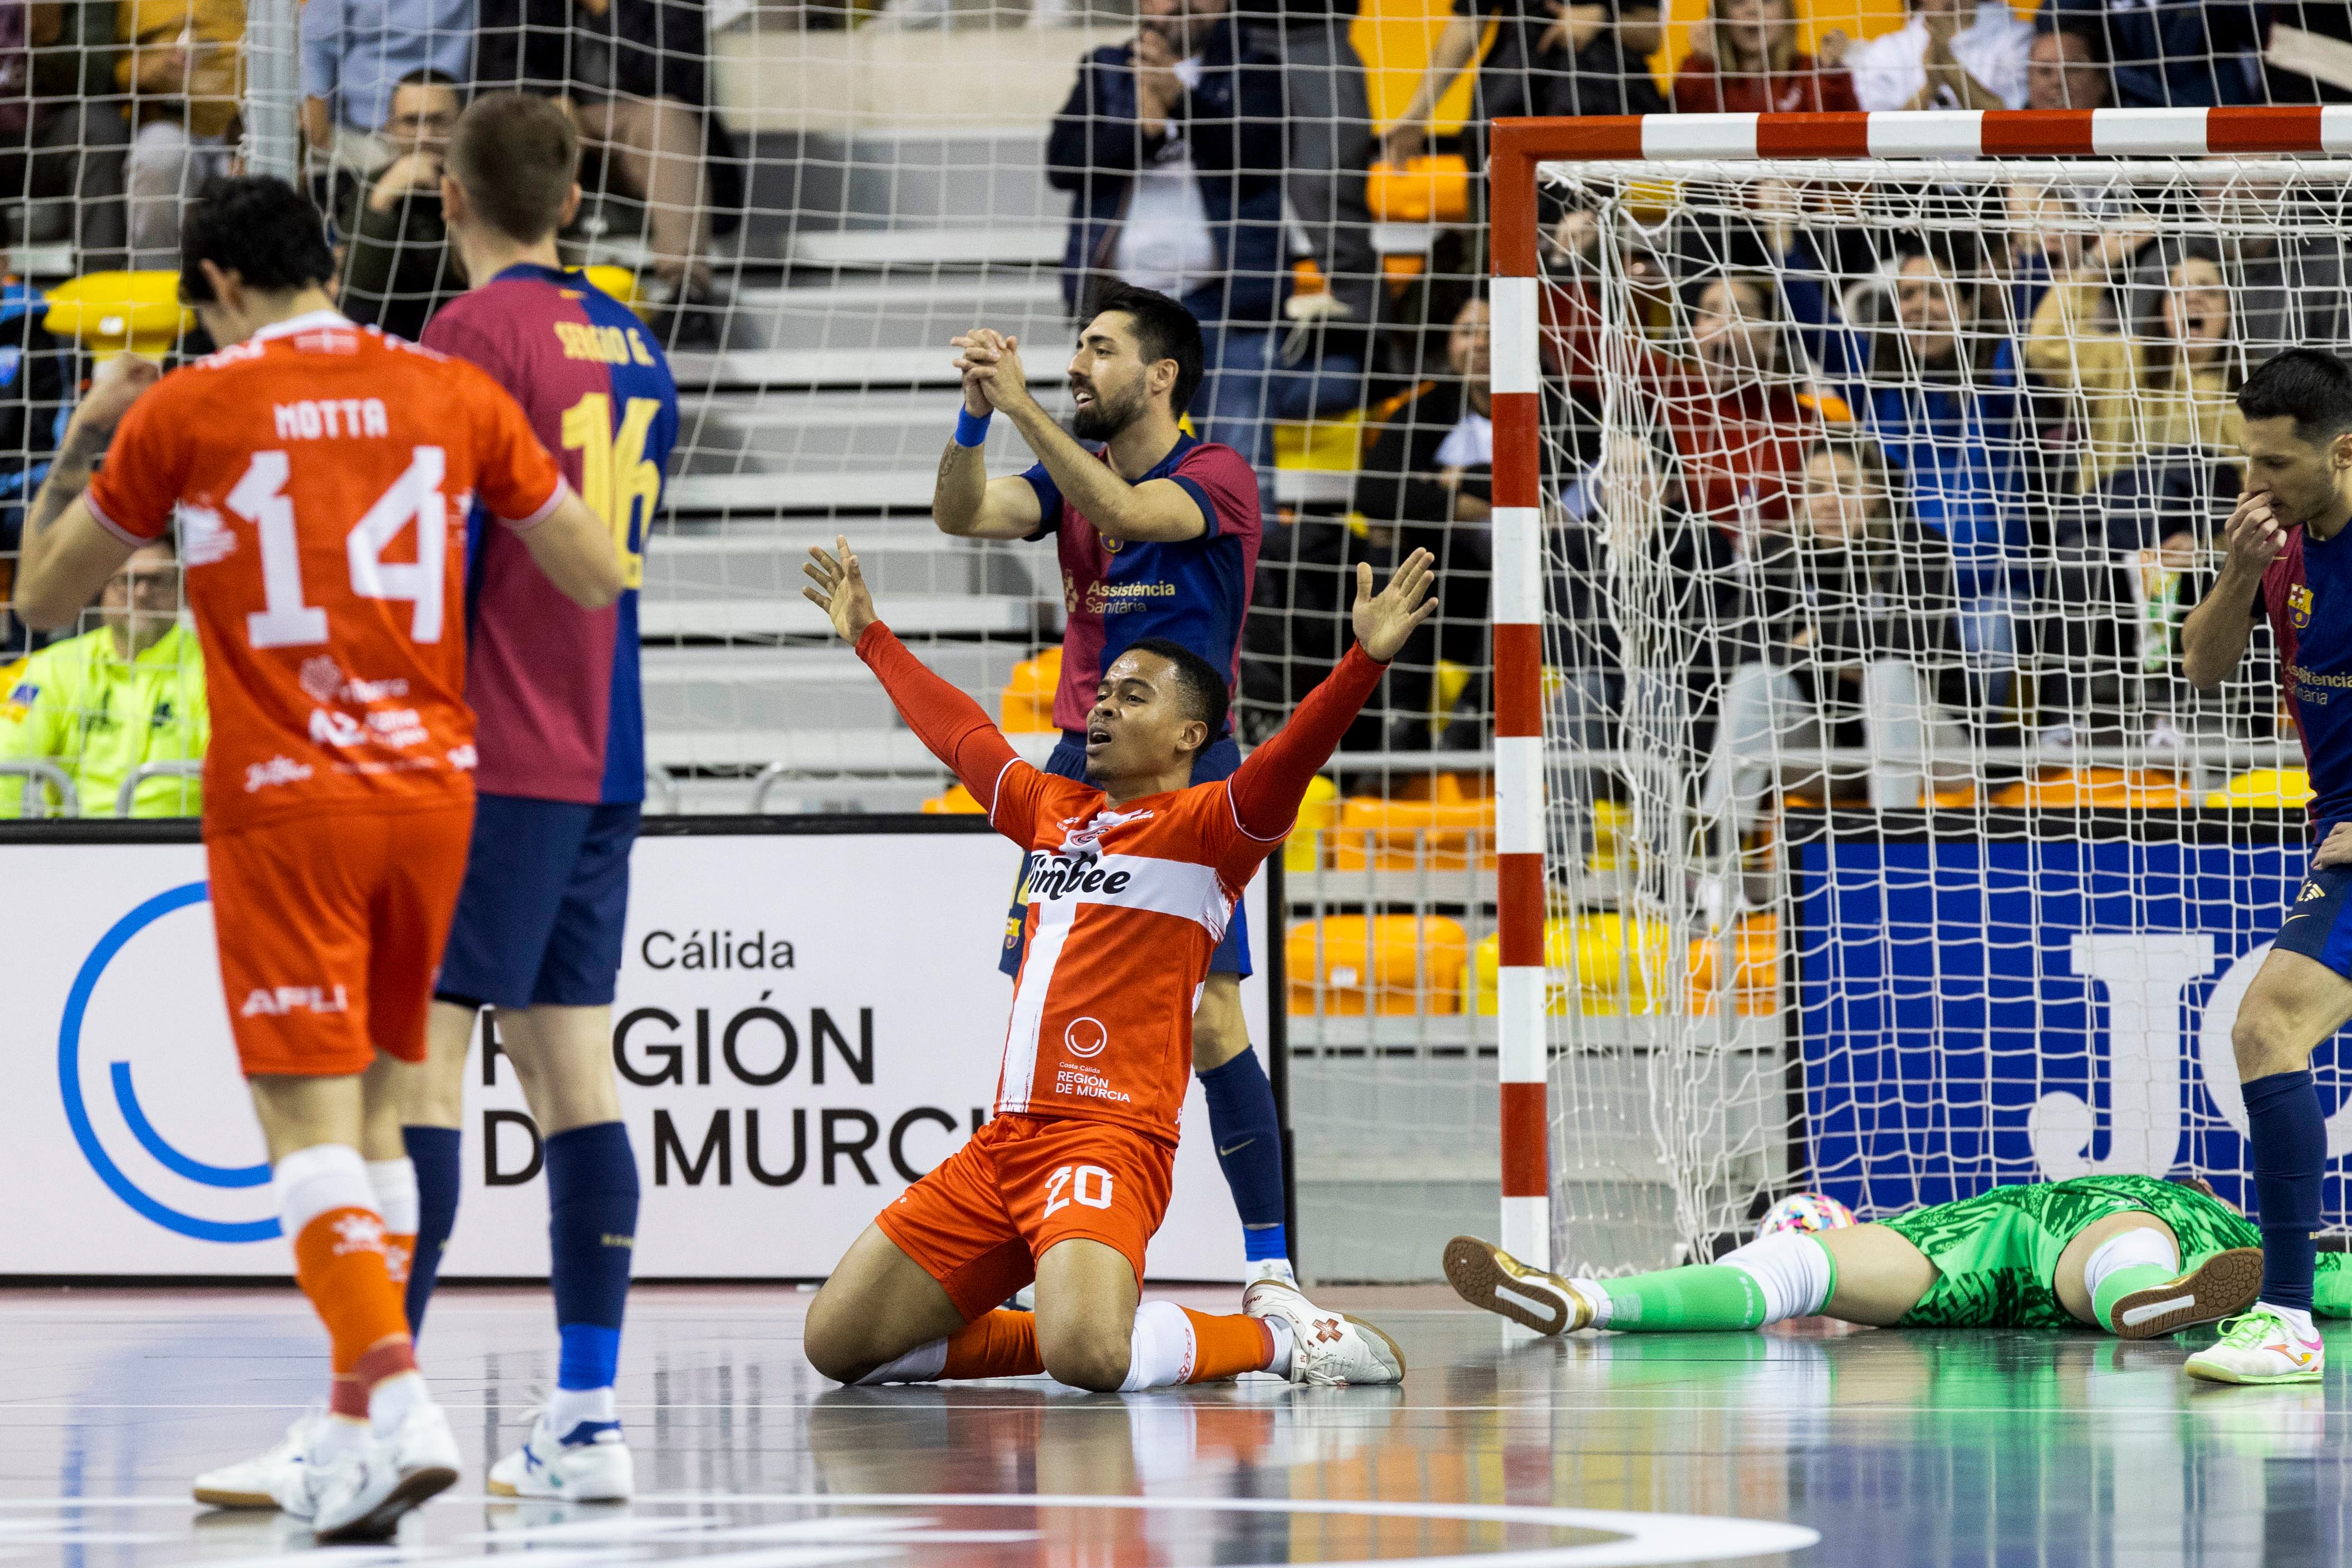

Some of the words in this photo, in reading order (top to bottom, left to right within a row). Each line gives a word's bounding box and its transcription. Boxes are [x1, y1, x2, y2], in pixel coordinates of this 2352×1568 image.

[273, 397, 389, 440] MOTTA
[561, 391, 661, 589] 16
[225, 445, 447, 649] 14
[641, 929, 796, 970] Cálida
[481, 990, 875, 1087] GIÓN
[1057, 1070, 1109, 1089] REGIÓN
[1059, 1061, 1078, 1070] Costa
[1080, 1065, 1101, 1074] Cálida
[1055, 1082, 1073, 1095] DE
[1076, 1085, 1131, 1103] MURCIA
[484, 1109, 545, 1187] D
[653, 1106, 984, 1187] MURC
[1042, 1165, 1114, 1221] 20
